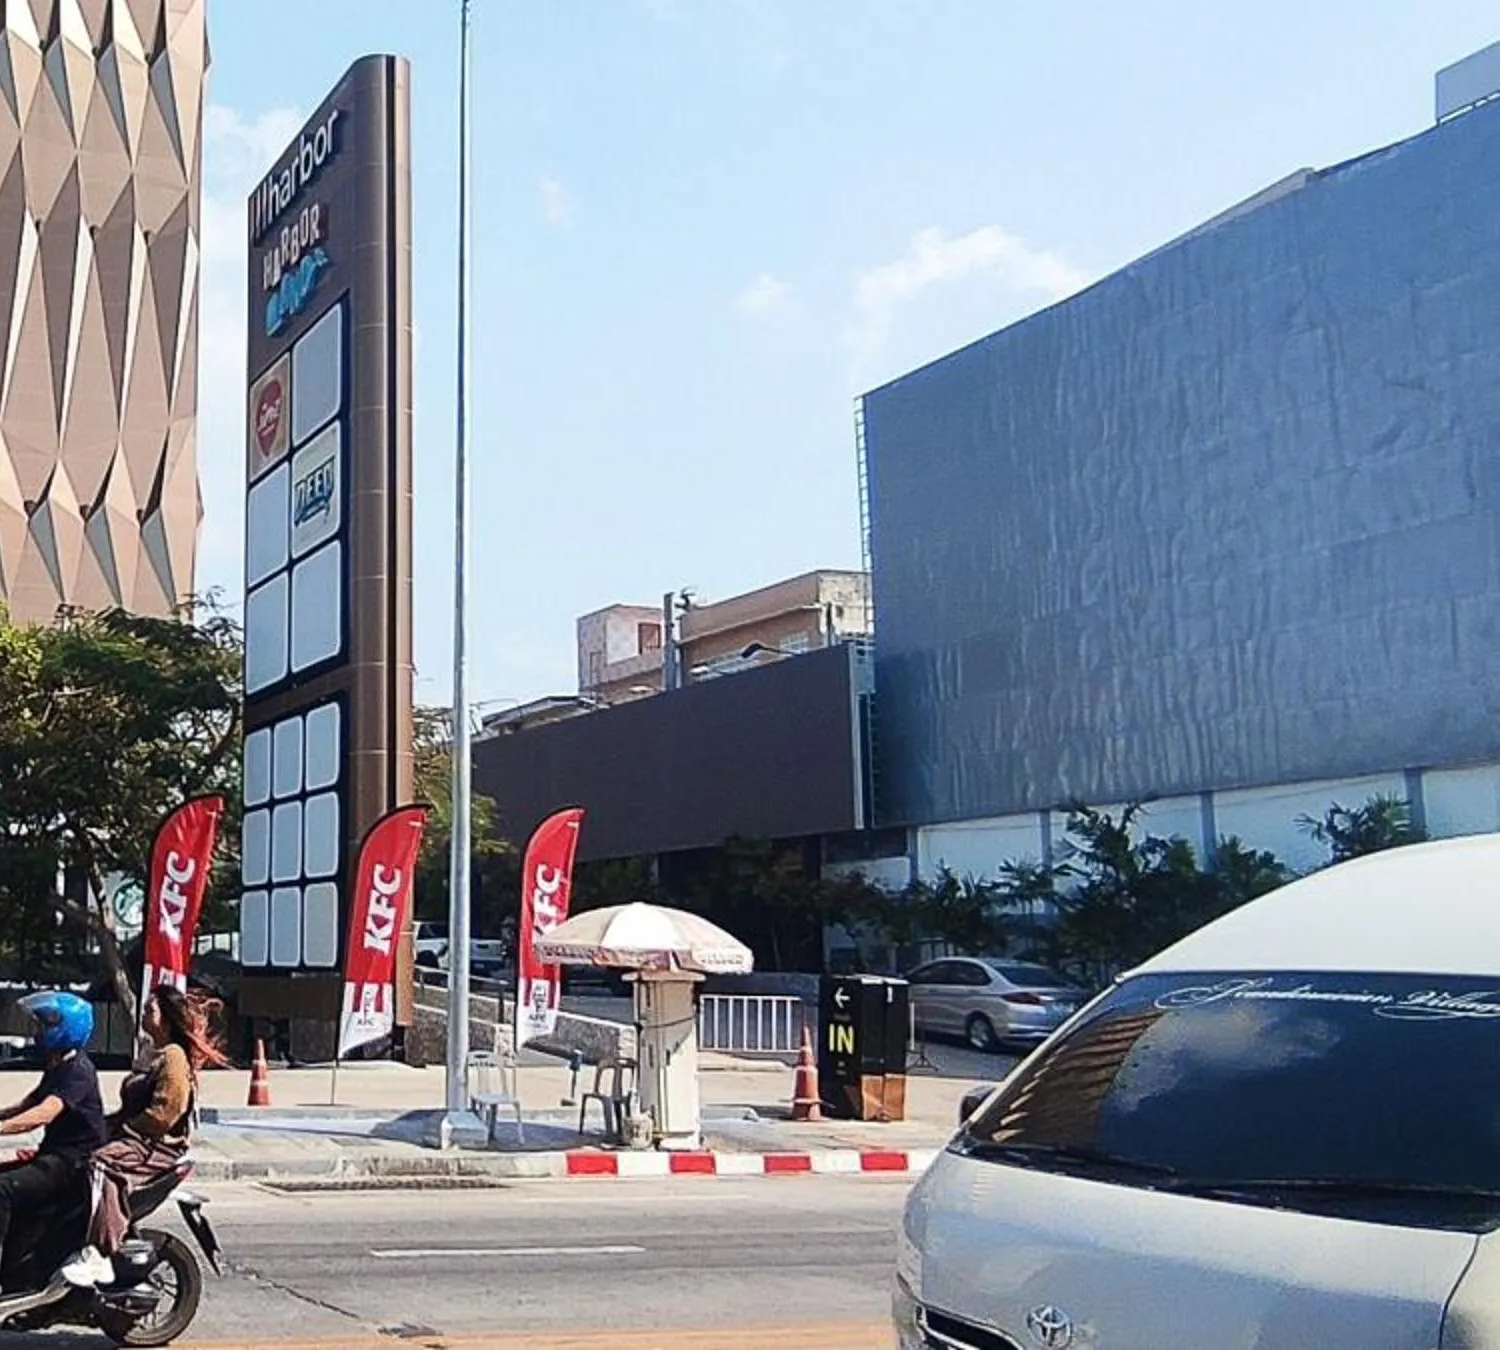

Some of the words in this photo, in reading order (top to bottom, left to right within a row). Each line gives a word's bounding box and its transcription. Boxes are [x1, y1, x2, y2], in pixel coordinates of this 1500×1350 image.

[268, 109, 340, 223] harbor
[263, 203, 322, 290] HARBOR
[159, 851, 195, 944] KFC
[363, 863, 402, 956] KFC
[828, 1022, 854, 1056] IN
